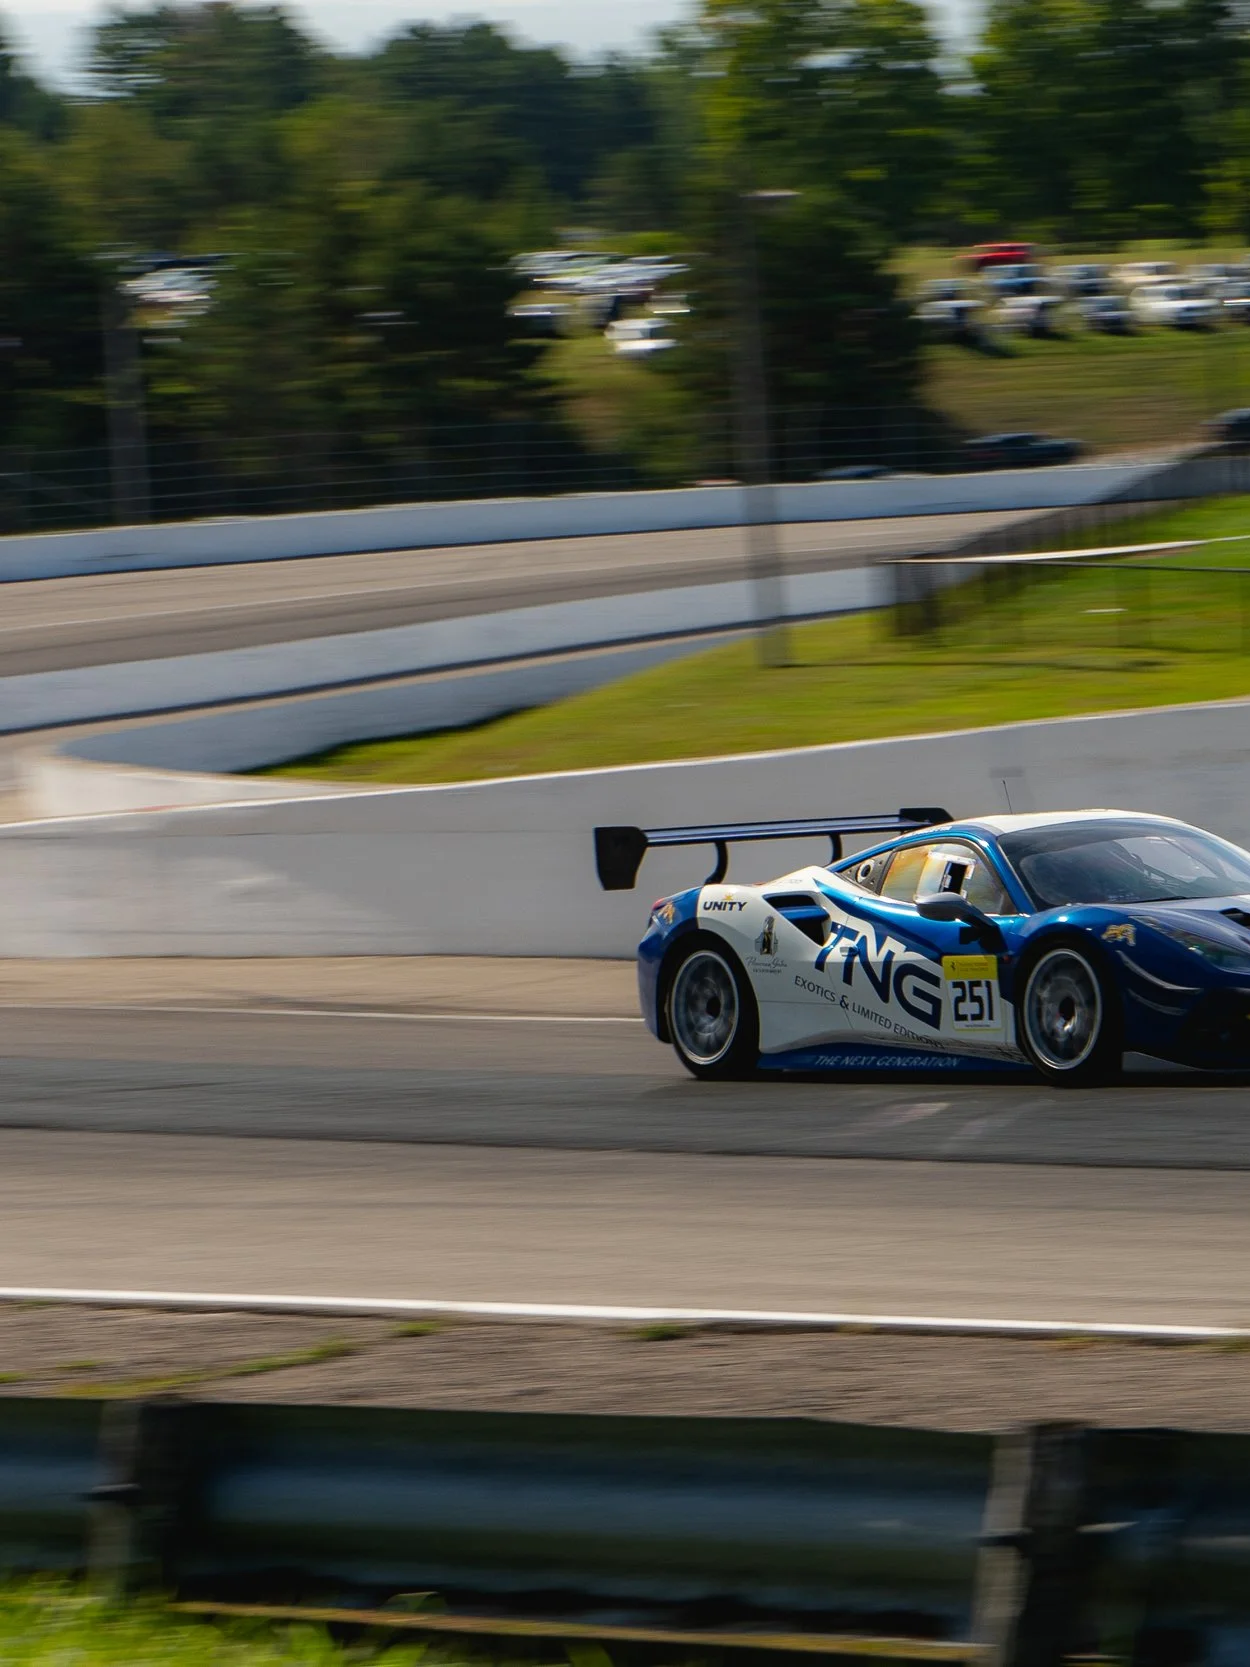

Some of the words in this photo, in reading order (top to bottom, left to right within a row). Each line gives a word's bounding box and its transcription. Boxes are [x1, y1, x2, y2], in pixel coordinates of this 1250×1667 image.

[703, 901, 748, 911] UNITY
[814, 921, 942, 1030] TNG
[794, 975, 836, 1002] EXOTICS
[839, 994, 850, 1011] &
[852, 1002, 892, 1030] LIMITED
[951, 980, 994, 1021] 251
[815, 1056, 842, 1066] THE
[840, 1056, 875, 1066] NEXT
[876, 1056, 960, 1067] GENERATION
